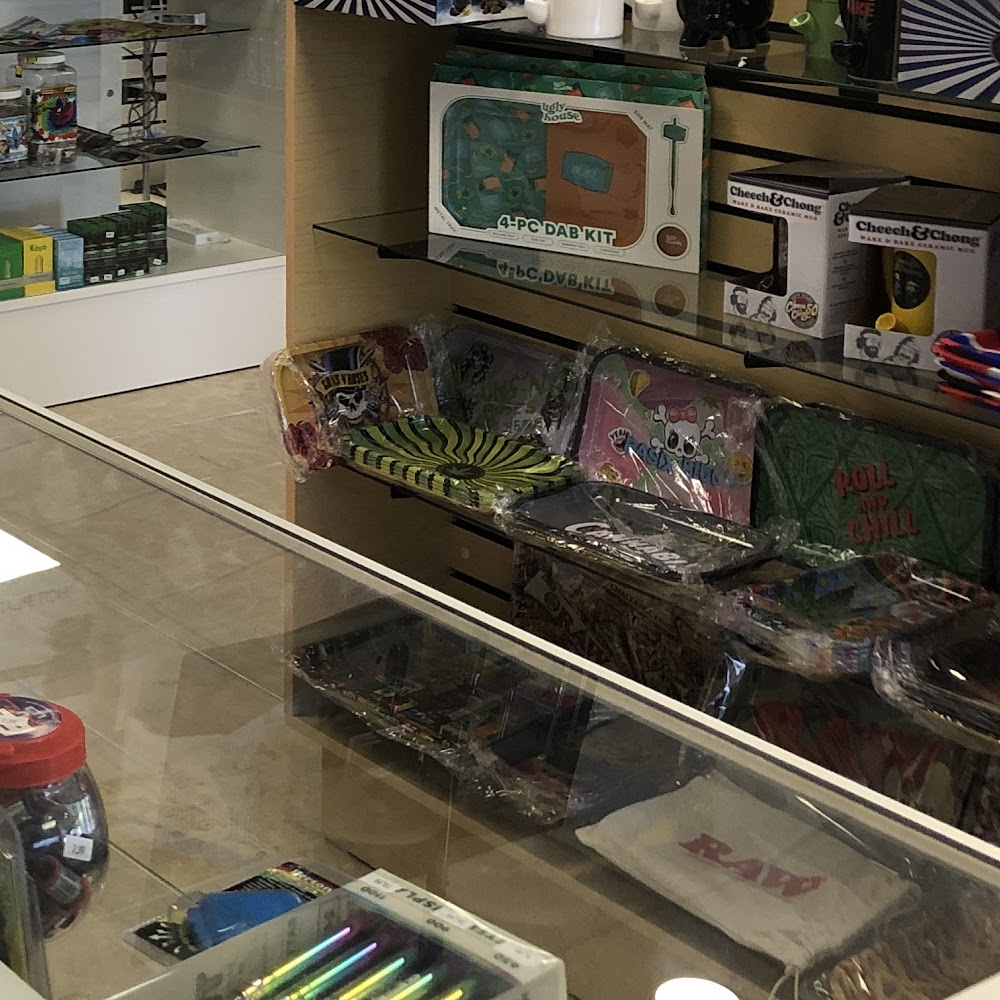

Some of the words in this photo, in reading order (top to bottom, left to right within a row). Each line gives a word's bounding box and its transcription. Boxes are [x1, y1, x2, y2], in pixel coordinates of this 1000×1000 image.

[542, 101, 566, 115] ugly
[543, 110, 581, 121] house
[774, 208, 803, 218] CERAMIC
[804, 213, 818, 221] MUG
[499, 215, 540, 233] 4-PC
[545, 222, 579, 239] DAB
[585, 228, 614, 245] KIT
[833, 461, 897, 498] ROLL
[857, 492, 889, 514] AND
[846, 504, 920, 545] CHILL
[678, 833, 827, 898] RAW
